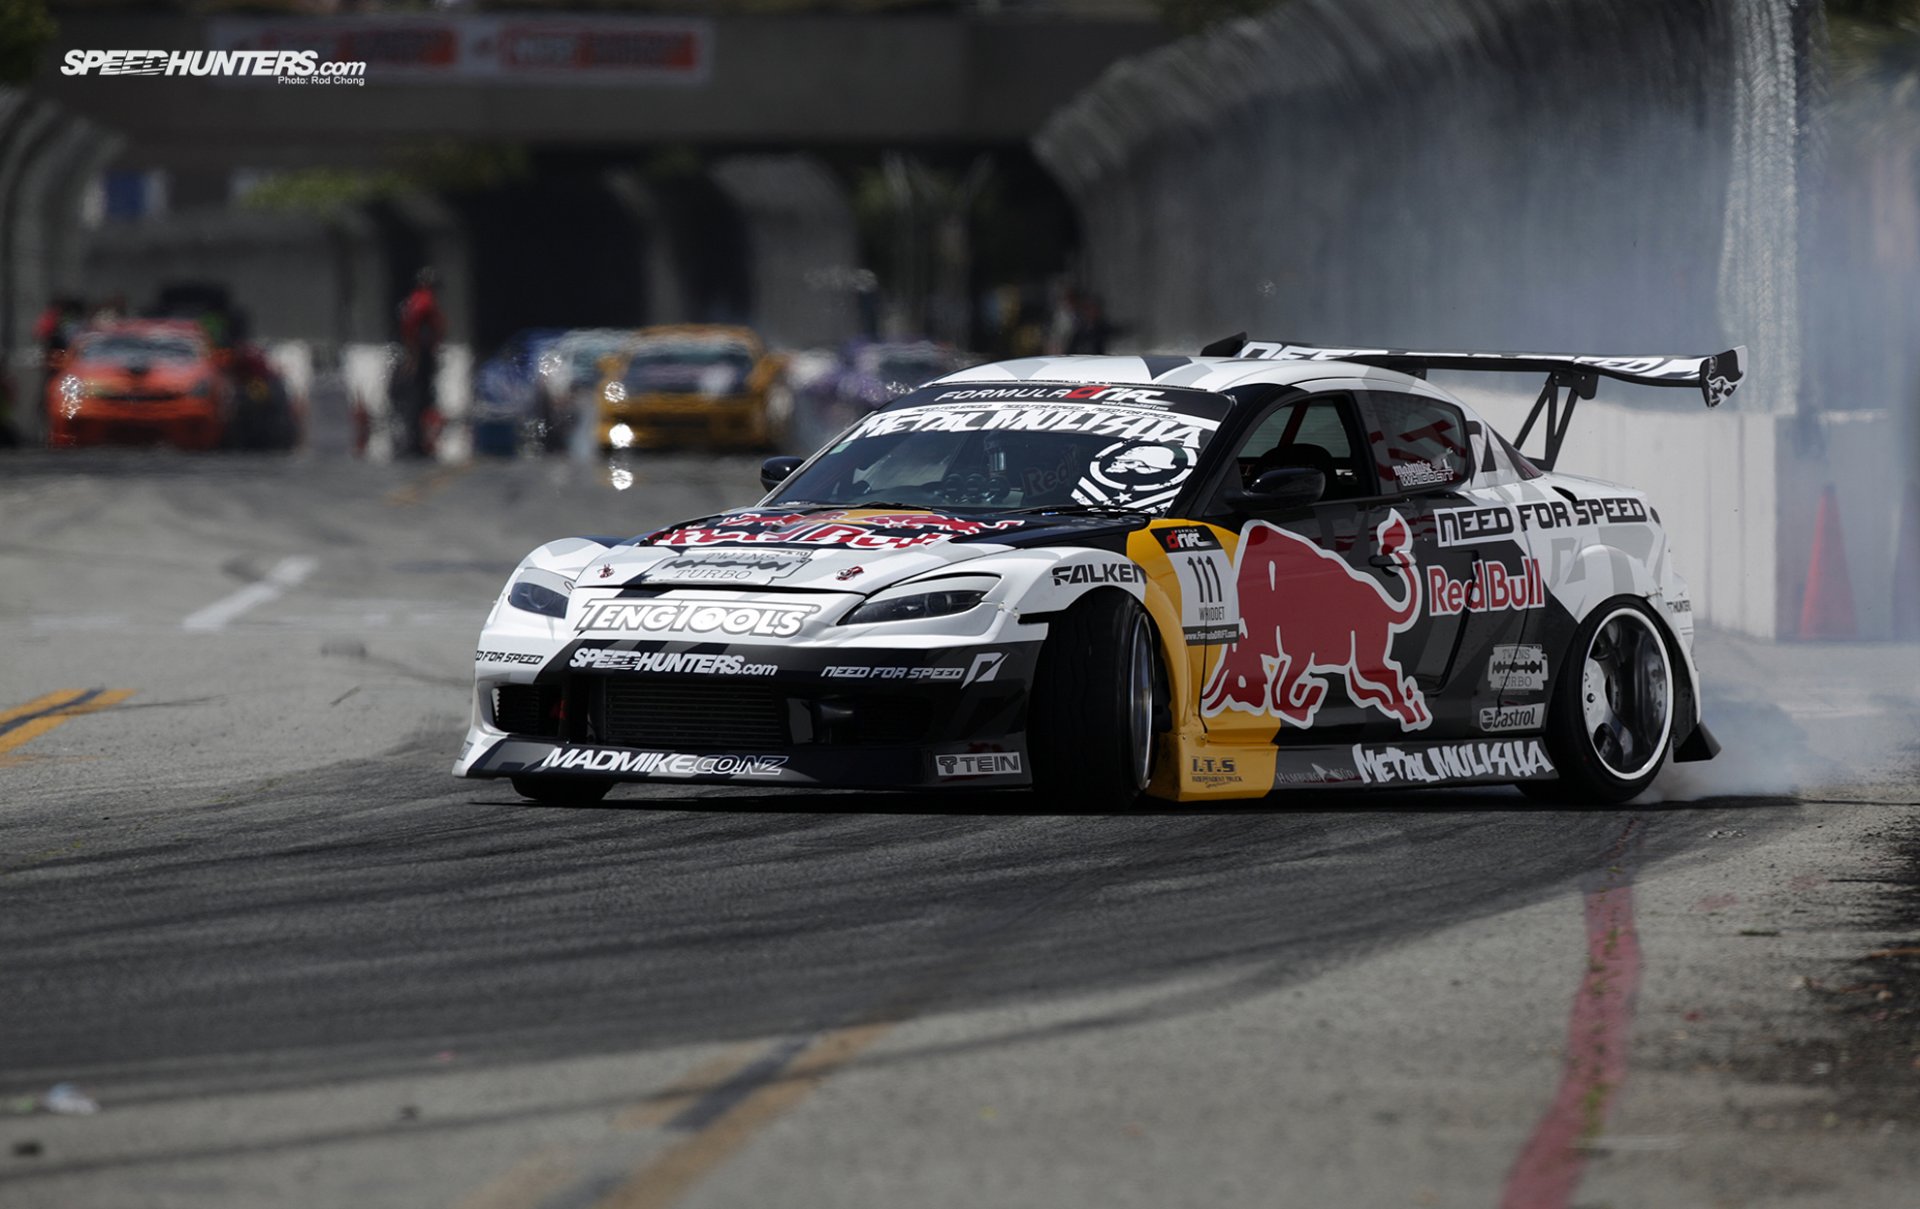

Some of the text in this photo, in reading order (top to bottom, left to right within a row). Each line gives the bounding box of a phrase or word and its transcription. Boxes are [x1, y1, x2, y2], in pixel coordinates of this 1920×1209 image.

[935, 388, 1069, 402] FORMULA
[843, 409, 986, 443] METAL
[1142, 412, 1178, 420] SPEED
[1437, 498, 1647, 542] NEED FOR SPEED
[673, 569, 752, 579] TURBO
[1050, 563, 1147, 586] FALKEN
[1187, 555, 1222, 603] 111
[1427, 556, 1545, 616] Red Bull
[483, 651, 507, 662] FOR
[504, 653, 544, 665] SPEED
[569, 648, 778, 676] SPEEDHUNTERS.com
[821, 666, 965, 680] NEED FOR SPEED
[1493, 707, 1535, 728] Castrol
[959, 755, 1019, 773] TEIN
